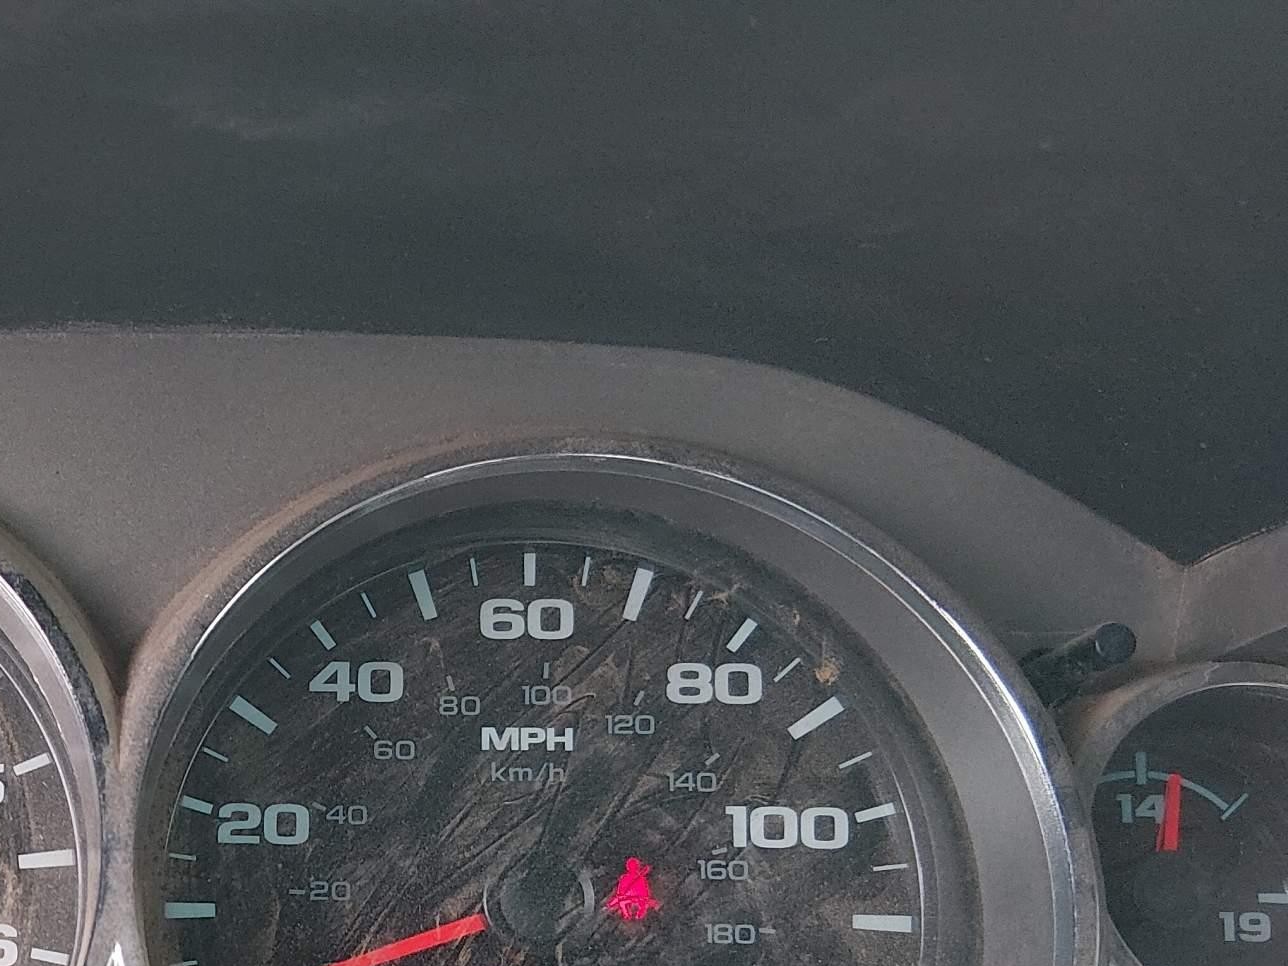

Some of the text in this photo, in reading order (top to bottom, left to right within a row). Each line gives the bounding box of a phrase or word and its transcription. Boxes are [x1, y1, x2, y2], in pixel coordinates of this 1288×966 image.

[478, 599, 575, 641] 60
[309, 661, 404, 703] 40
[665, 663, 763, 705] 80
[438, 696, 481, 717] 80
[522, 685, 572, 706] 100
[605, 715, 655, 736] 120
[373, 740, 416, 761] 60
[480, 727, 574, 753] MPH
[490, 761, 566, 785] km/h
[667, 772, 718, 793] 140
[325, 805, 368, 826] 40
[1116, 793, 1167, 824] 14
[216, 803, 311, 846] 20
[724, 805, 849, 850] 100
[697, 859, 750, 882] 160
[310, 881, 352, 902] 20
[704, 924, 756, 945] 180
[1218, 911, 1272, 943] 19
